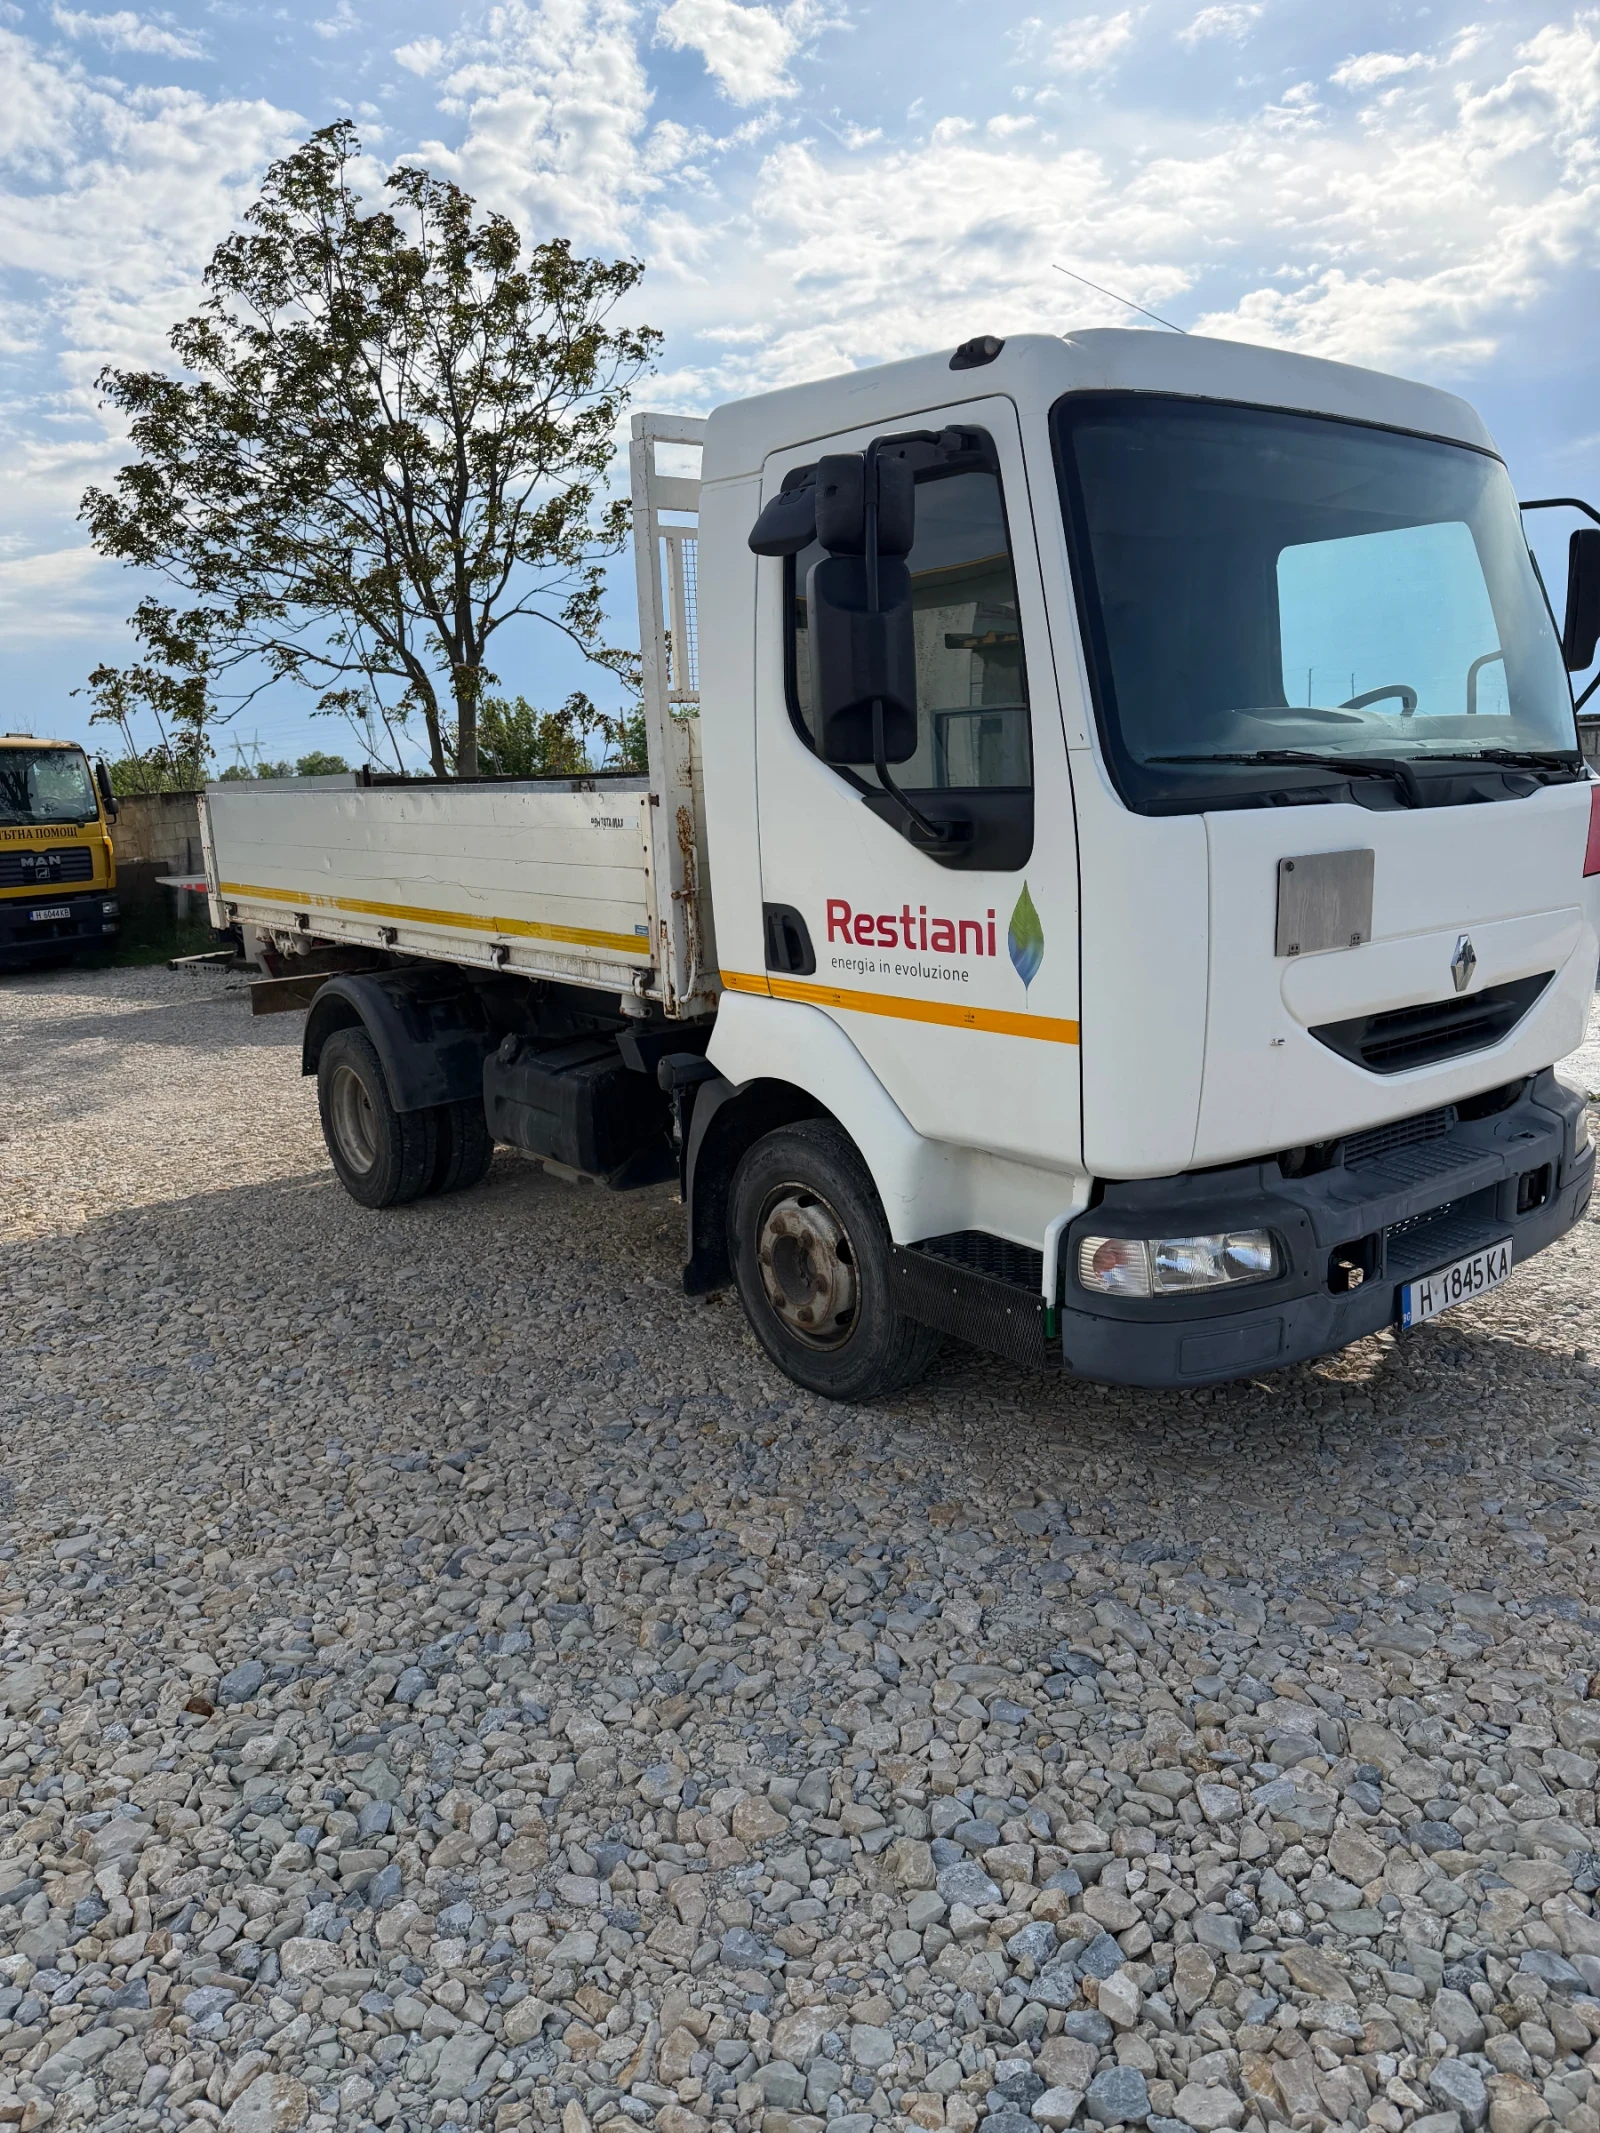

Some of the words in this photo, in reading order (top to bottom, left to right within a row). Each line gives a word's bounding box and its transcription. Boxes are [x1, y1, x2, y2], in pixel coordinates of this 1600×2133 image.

[0, 829, 33, 841] ЪТНА
[35, 826, 78, 839] ПОМОЩ
[20, 855, 61, 867] MAN
[826, 898, 996, 957] Restiani
[831, 957, 875, 975] energia
[879, 958, 891, 974] in
[894, 962, 970, 983] evoluzione
